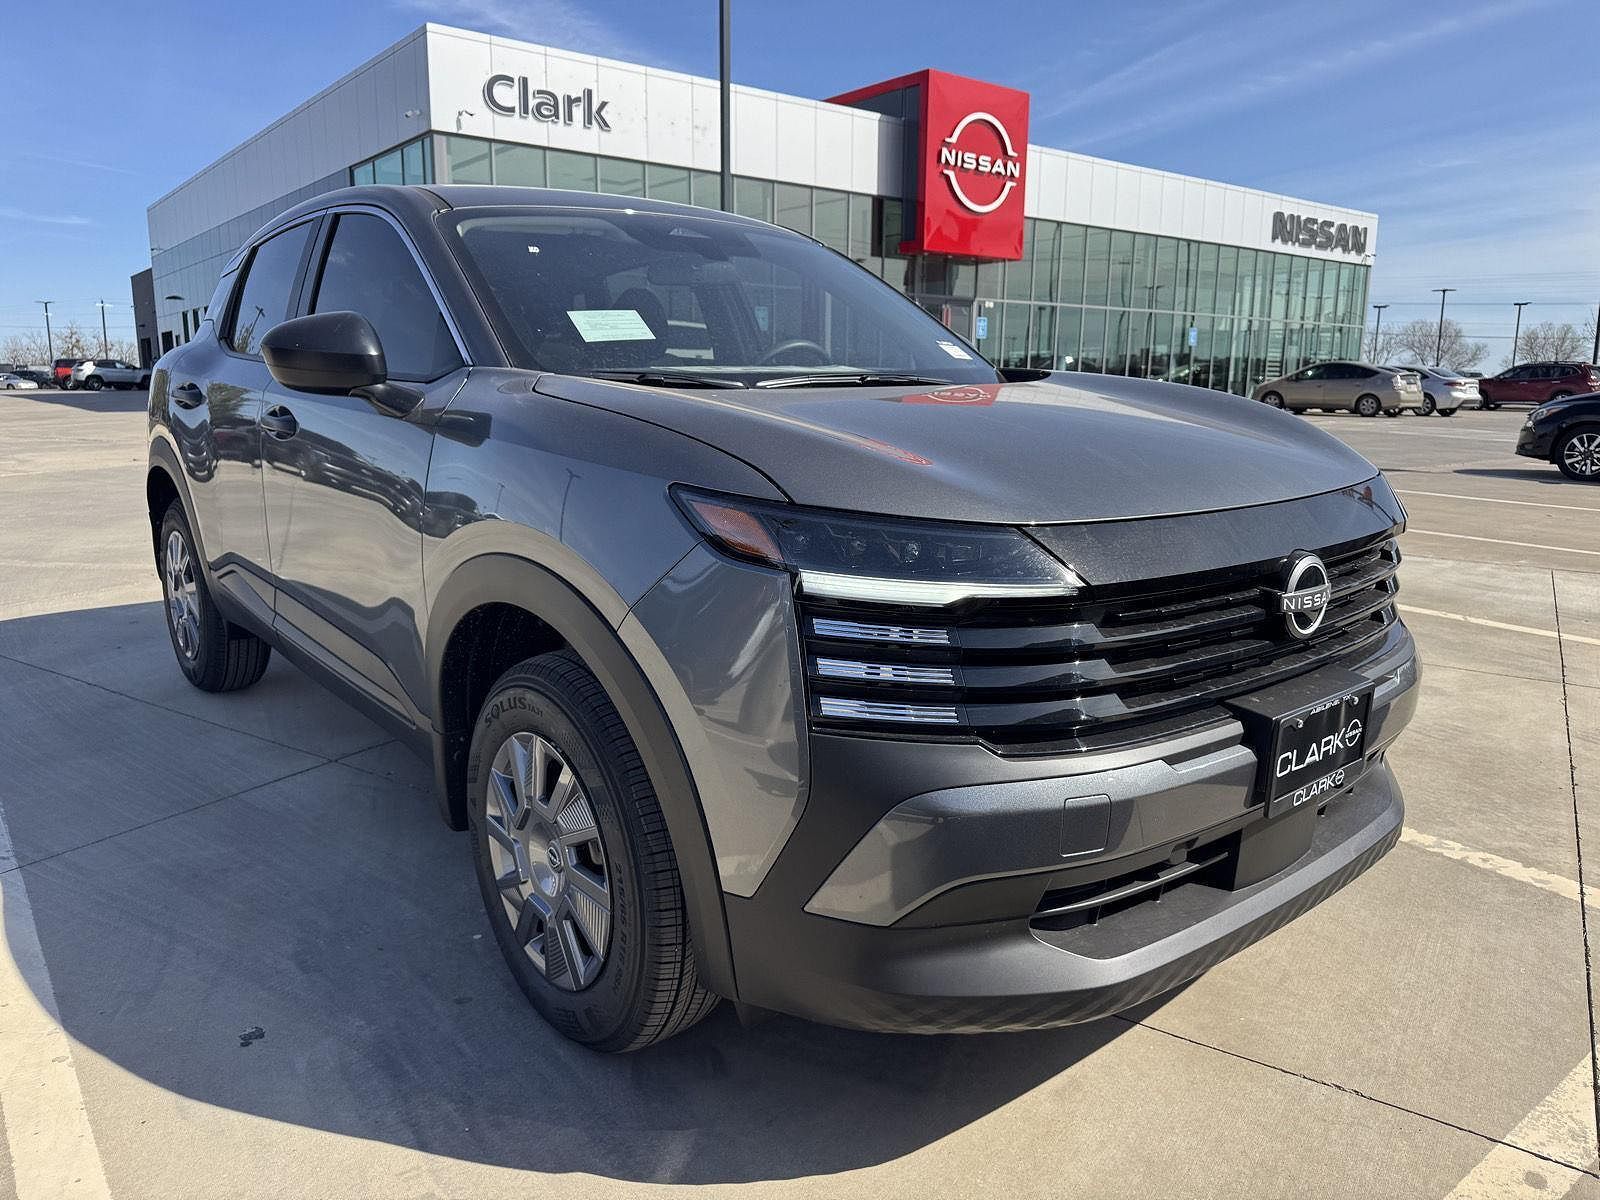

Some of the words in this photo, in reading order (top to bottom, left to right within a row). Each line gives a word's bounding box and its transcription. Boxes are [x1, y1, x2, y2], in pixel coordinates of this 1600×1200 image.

[482, 74, 612, 132] Clark
[941, 147, 1020, 178] NISSAN
[1271, 211, 1368, 256] NISSAN
[485, 696, 527, 728] SOLUS
[1277, 727, 1346, 778] CLARK
[1293, 773, 1336, 807] CLARK
